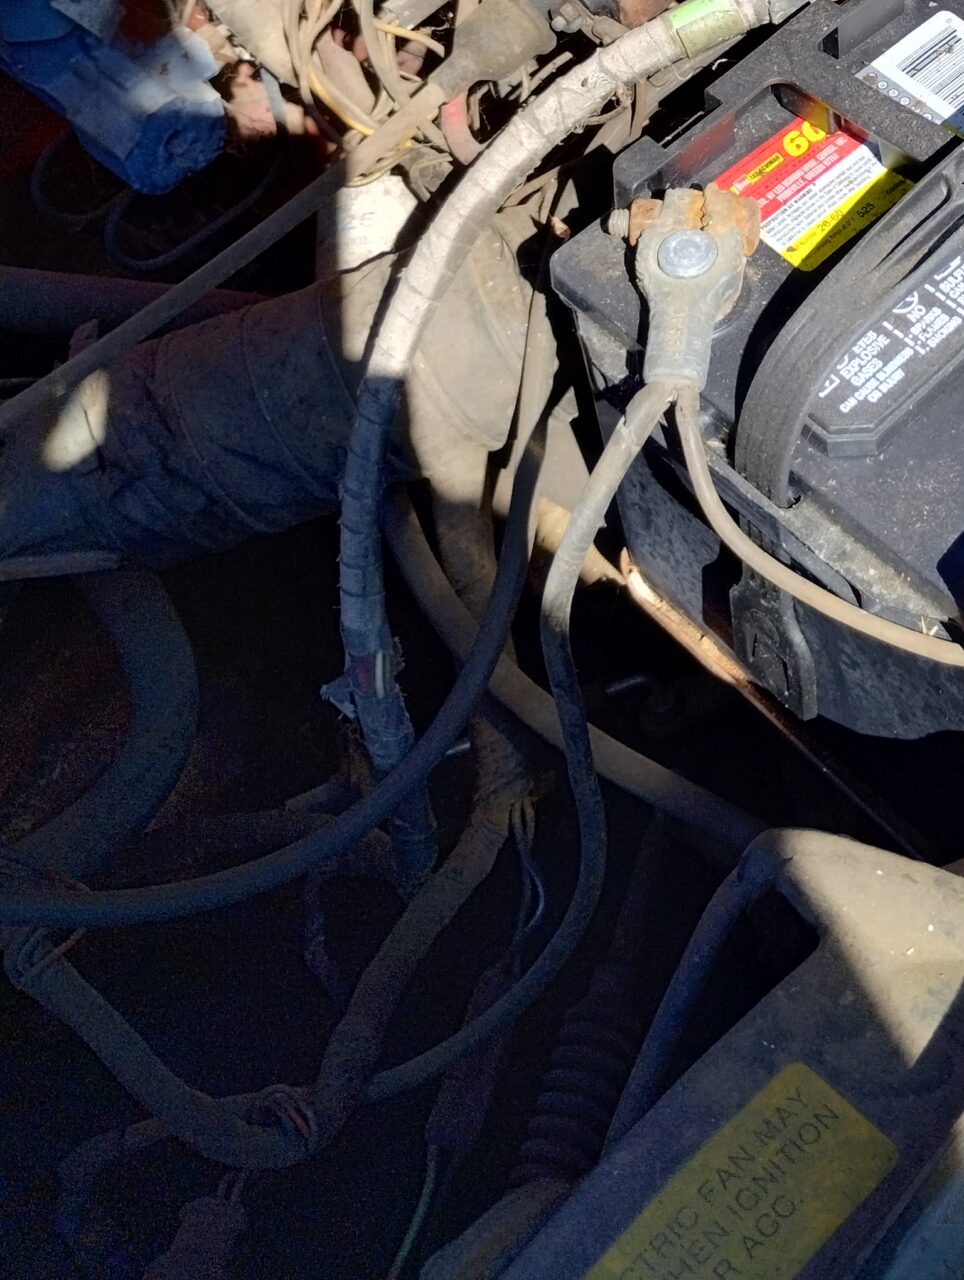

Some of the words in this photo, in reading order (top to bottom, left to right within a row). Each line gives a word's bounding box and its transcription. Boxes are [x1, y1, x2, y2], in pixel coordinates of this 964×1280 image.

[854, 199, 877, 220] 525
[905, 302, 928, 324] NO
[916, 310, 951, 343] FLAMES
[925, 313, 964, 350] SMOKING
[839, 331, 892, 382] EXPLOSIVE
[851, 328, 878, 354] EYES
[849, 355, 885, 389] GASES
[838, 394, 859, 415] CAN
[852, 375, 881, 402] CAUSE
[692, 1141, 759, 1208] FAN
[749, 1084, 814, 1150] MAY
[721, 1100, 845, 1224] IGNITION
[731, 1183, 809, 1261] ACC.
